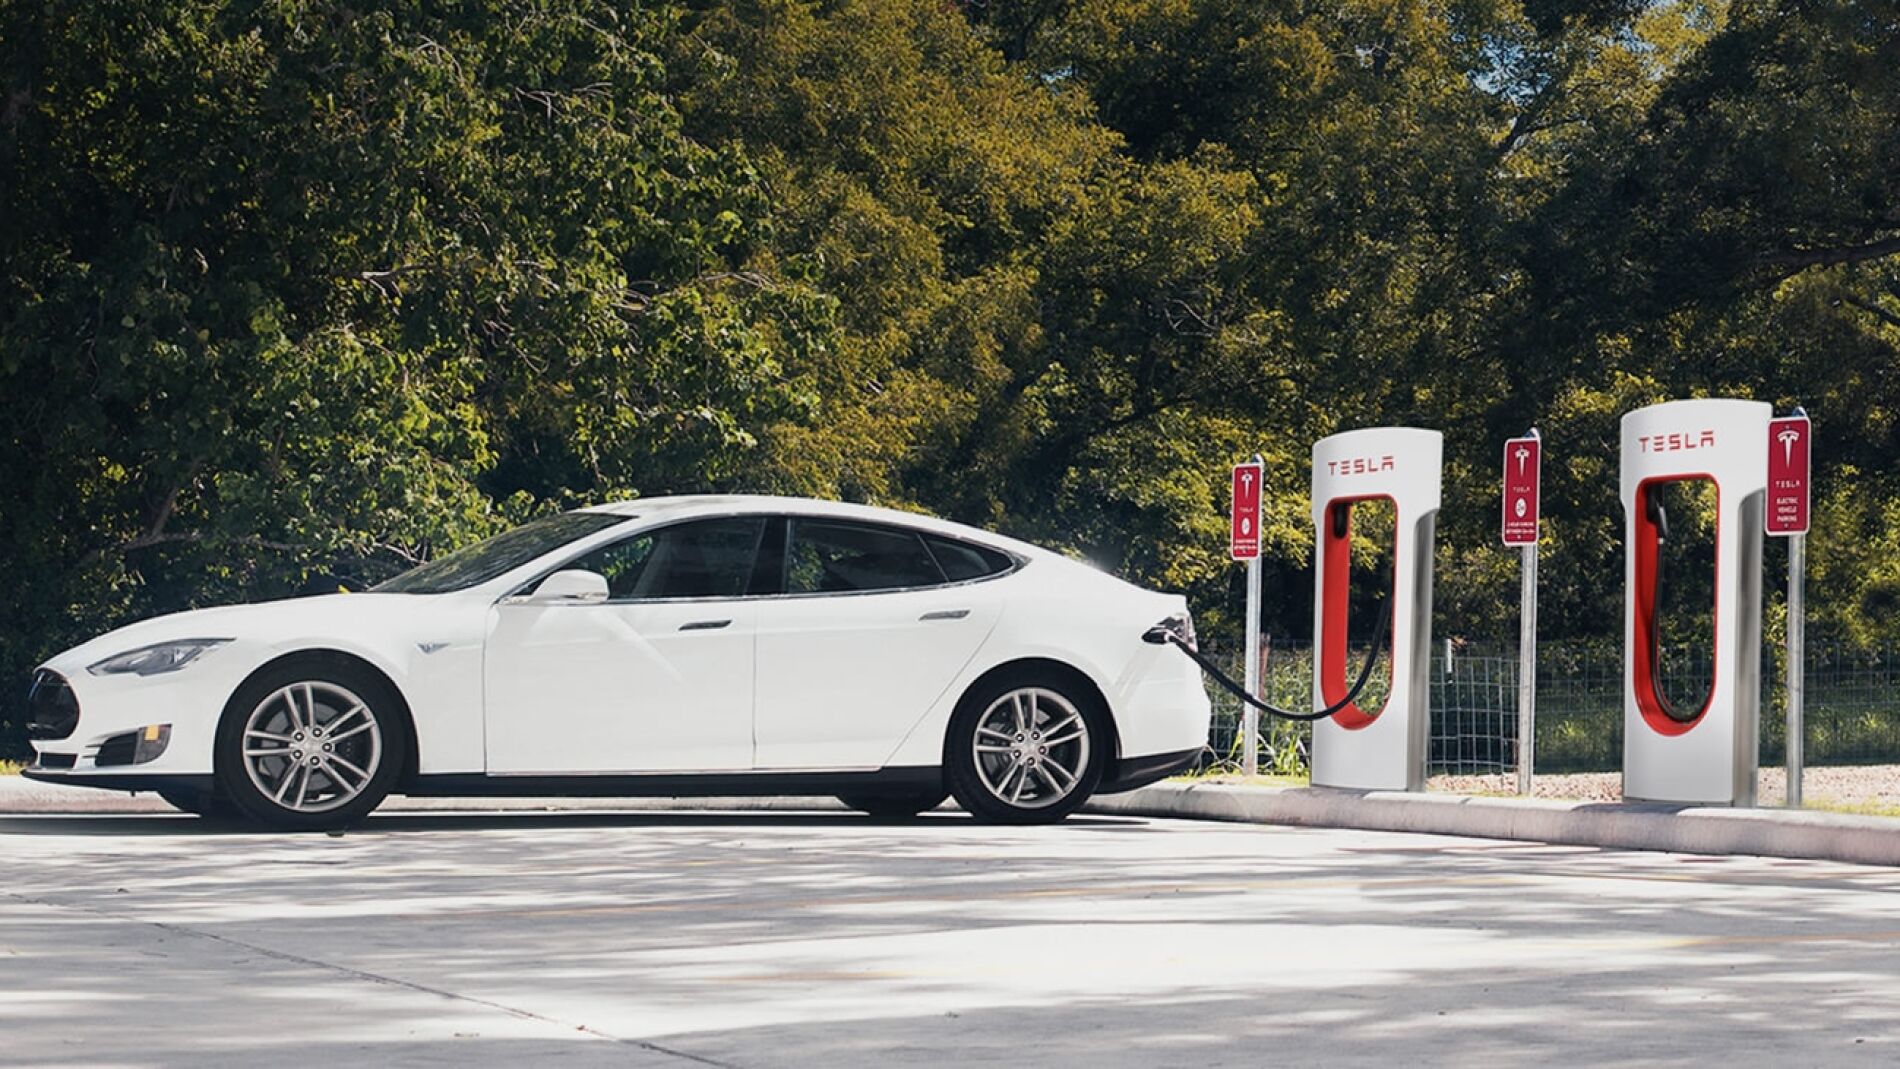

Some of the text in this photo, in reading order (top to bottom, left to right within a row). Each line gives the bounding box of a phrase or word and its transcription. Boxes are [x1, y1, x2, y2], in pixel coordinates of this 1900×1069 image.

[1638, 430, 1714, 452] TESLA
[1328, 455, 1394, 476] TESLA
[1775, 480, 1800, 488] TESLA
